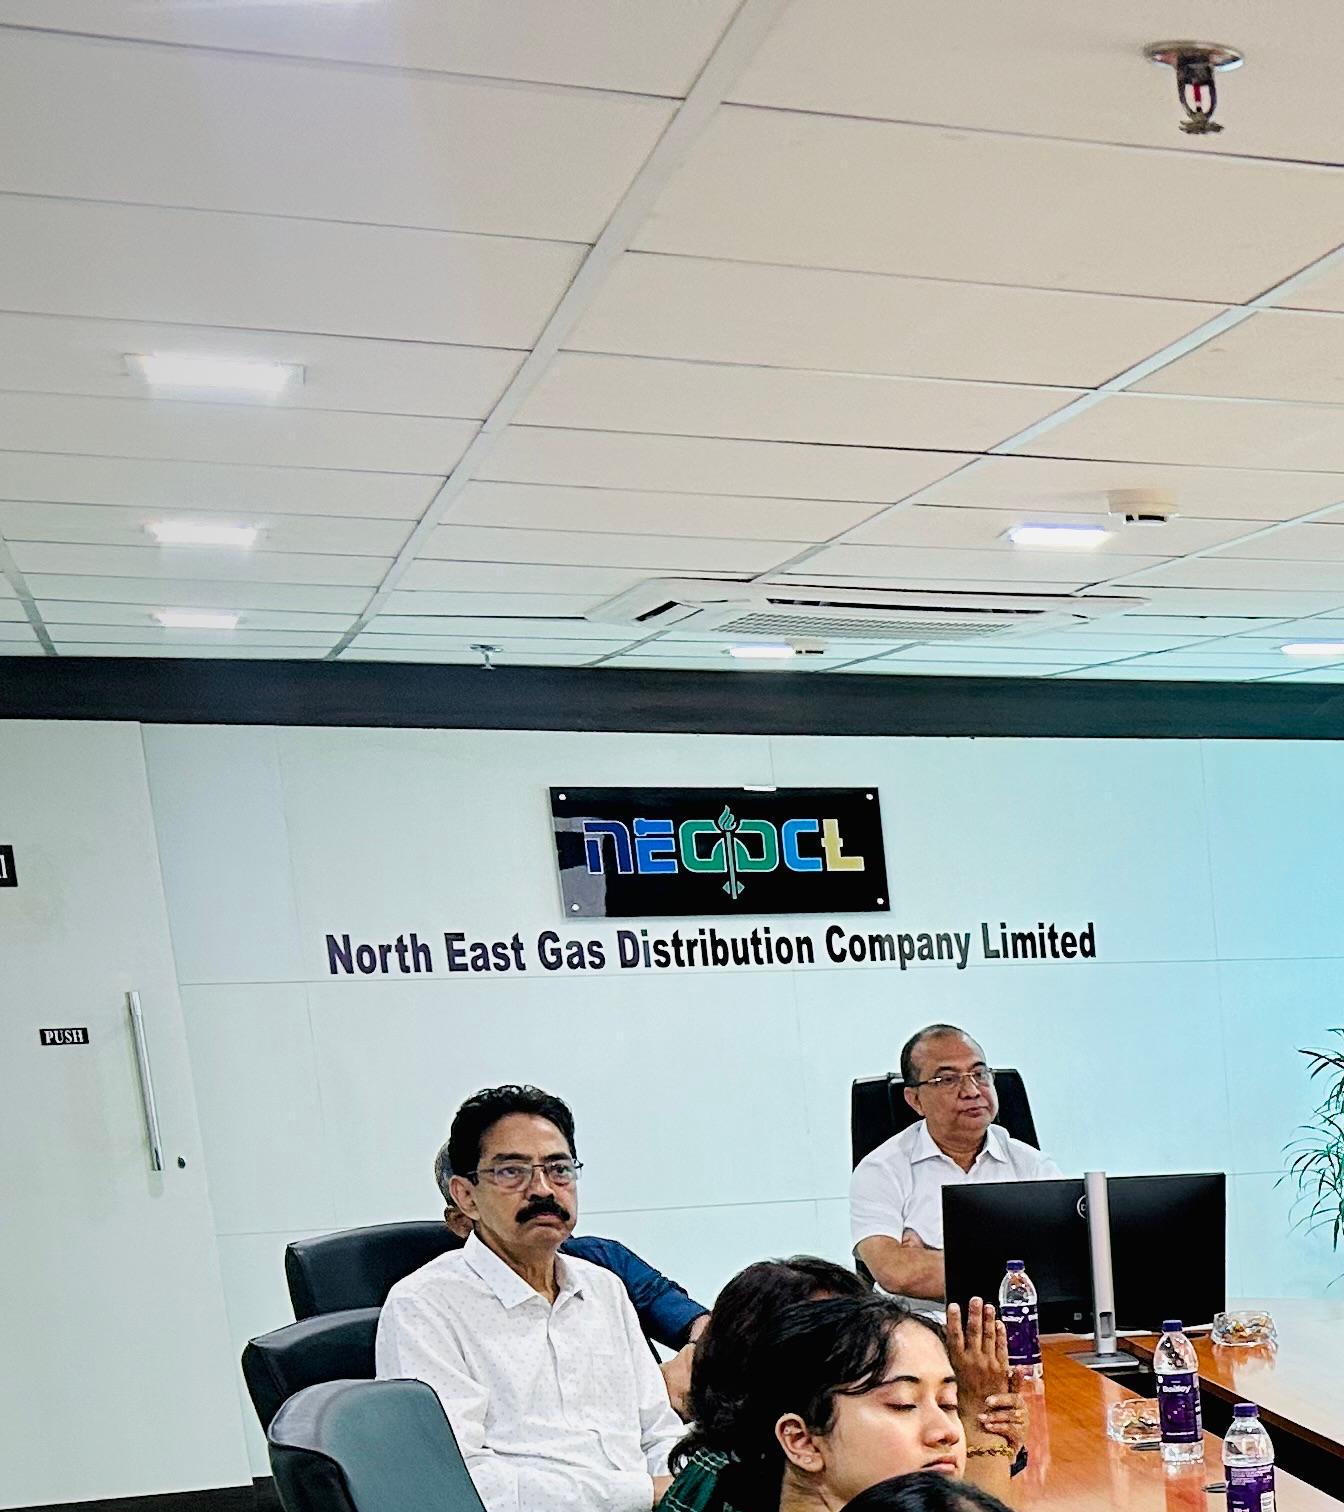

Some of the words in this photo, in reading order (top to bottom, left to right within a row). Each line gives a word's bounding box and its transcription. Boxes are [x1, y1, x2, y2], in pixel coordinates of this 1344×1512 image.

[325, 932, 434, 975] North
[444, 931, 527, 972] East
[537, 930, 606, 971] Gas
[616, 926, 815, 969] Distribution
[825, 924, 971, 971] Company
[981, 921, 1097, 960] Limited
[43, 1029, 84, 1044] PUSH
